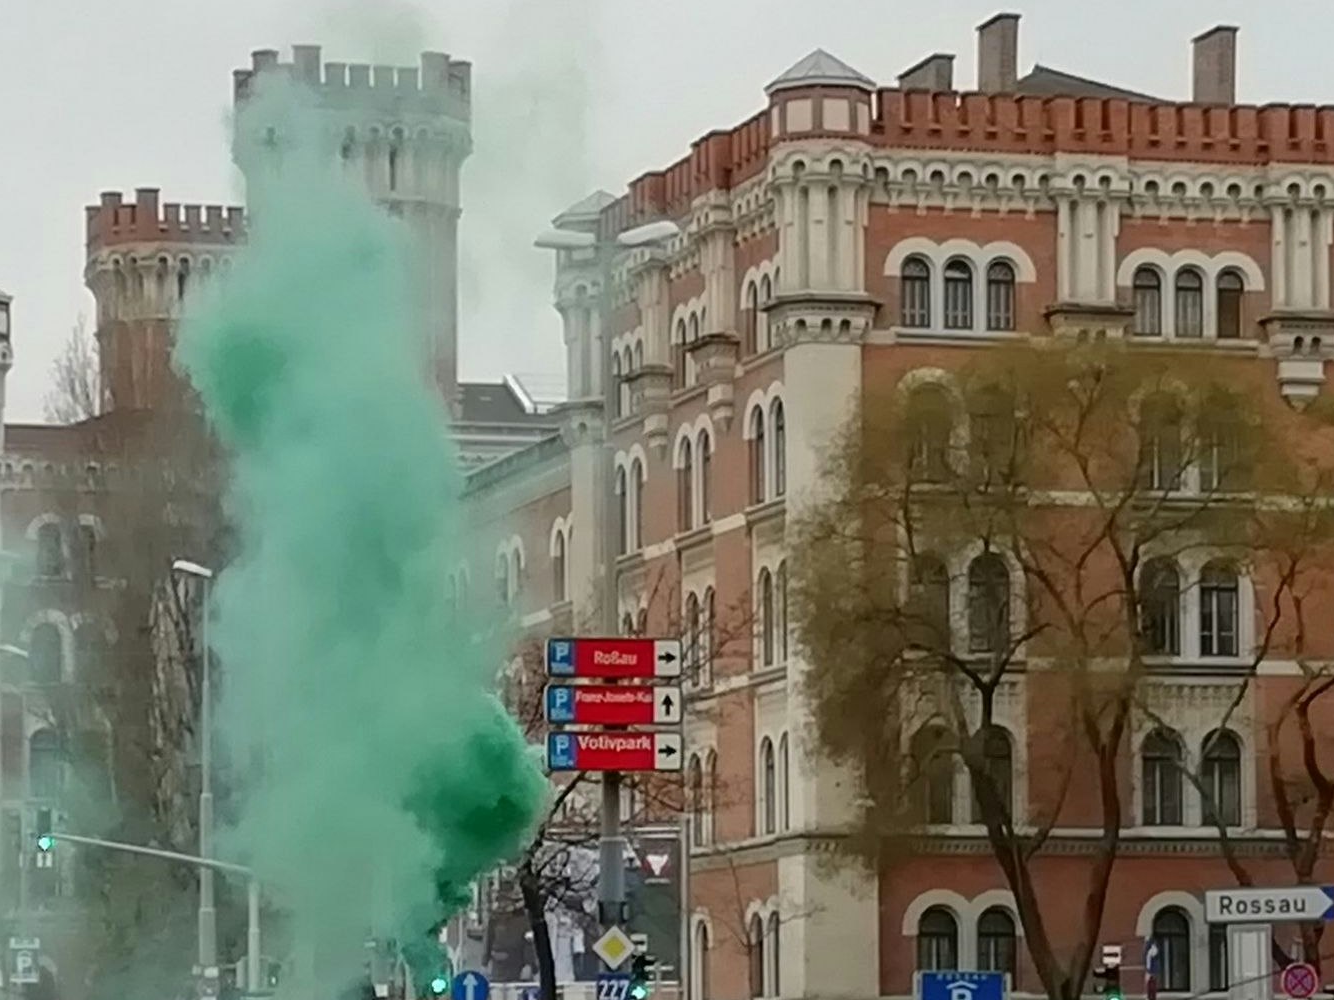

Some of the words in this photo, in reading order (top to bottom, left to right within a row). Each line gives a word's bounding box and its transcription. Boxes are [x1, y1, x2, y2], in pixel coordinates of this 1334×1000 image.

[593, 650, 638, 665] Roßau
[578, 735, 651, 752] Votivpark
[1219, 895, 1306, 915] Rossau
[598, 980, 630, 1000] 227
